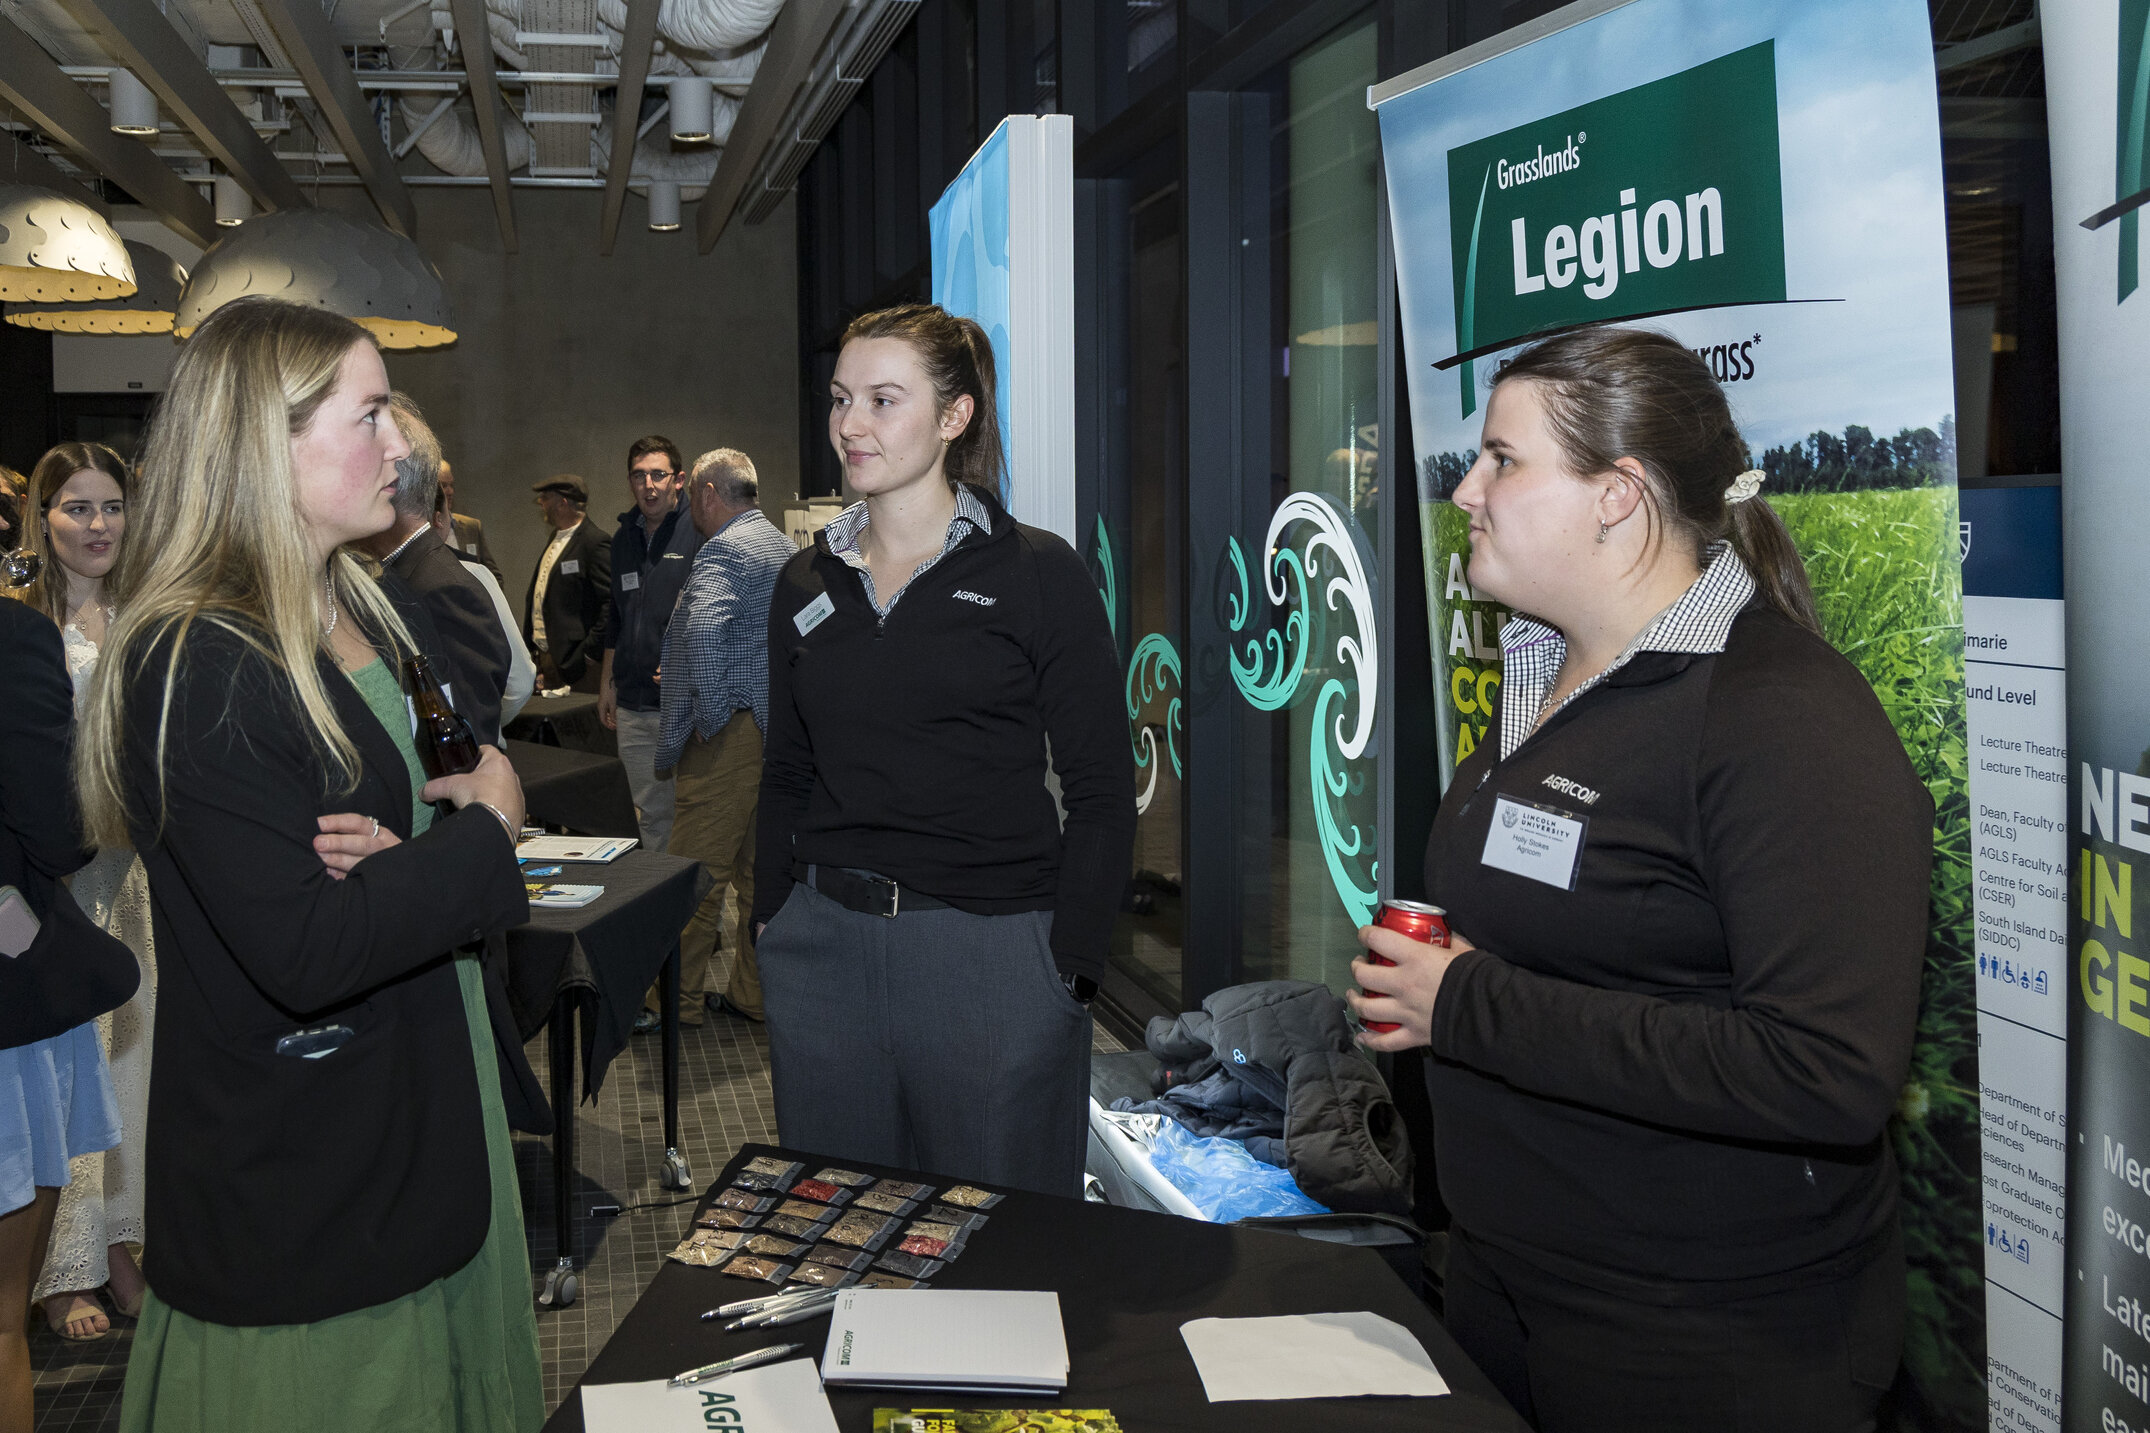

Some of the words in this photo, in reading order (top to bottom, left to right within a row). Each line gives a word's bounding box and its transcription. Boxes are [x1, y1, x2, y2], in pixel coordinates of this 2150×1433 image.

[1511, 187, 1724, 300] Legion
[952, 589, 997, 607] AGRICOM
[1966, 685, 1993, 701] und
[1997, 687, 2036, 706] Level
[1981, 735, 2021, 751] Lecture
[2025, 741, 2067, 758] Theatre
[1980, 759, 2021, 776] Lecture
[2024, 766, 2067, 784] Theatre
[1541, 774, 1600, 806] AGRICOM
[1522, 812, 1556, 827] LINCOLN
[1980, 805, 2010, 822] Dean,
[2013, 811, 2054, 832] Faculty
[2082, 761, 2150, 854] NE
[1521, 820, 1570, 838] UNIVERSITY
[1980, 821, 2017, 842] (AGLS)
[1512, 834, 1527, 844] Holly
[1528, 839, 1550, 851] Stokes
[1517, 845, 1542, 857] Agricom
[1980, 846, 2009, 863] AGLS
[2012, 853, 2052, 875] Faculty
[1979, 887, 2015, 908] (CSER)
[1980, 870, 2016, 889] Centre
[2019, 879, 2034, 893] for
[2037, 884, 2058, 900] Soil
[2082, 847, 2132, 939] IN
[1979, 911, 2010, 930] South
[2013, 920, 2046, 940] Island
[1979, 927, 2020, 952] (SIDDC)
[2080, 939, 2150, 1038] GE
[1979, 1082, 2041, 1118] Department
[2044, 1111, 2056, 1123] of
[2007, 1120, 2018, 1132] of
[1983, 1151, 2025, 1177] esearch
[2001, 1181, 2053, 1215] Graduate
[841, 1329, 854, 1361] AGRICOM
[2040, 1388, 2052, 1401] of
[2003, 1408, 2014, 1420] of
